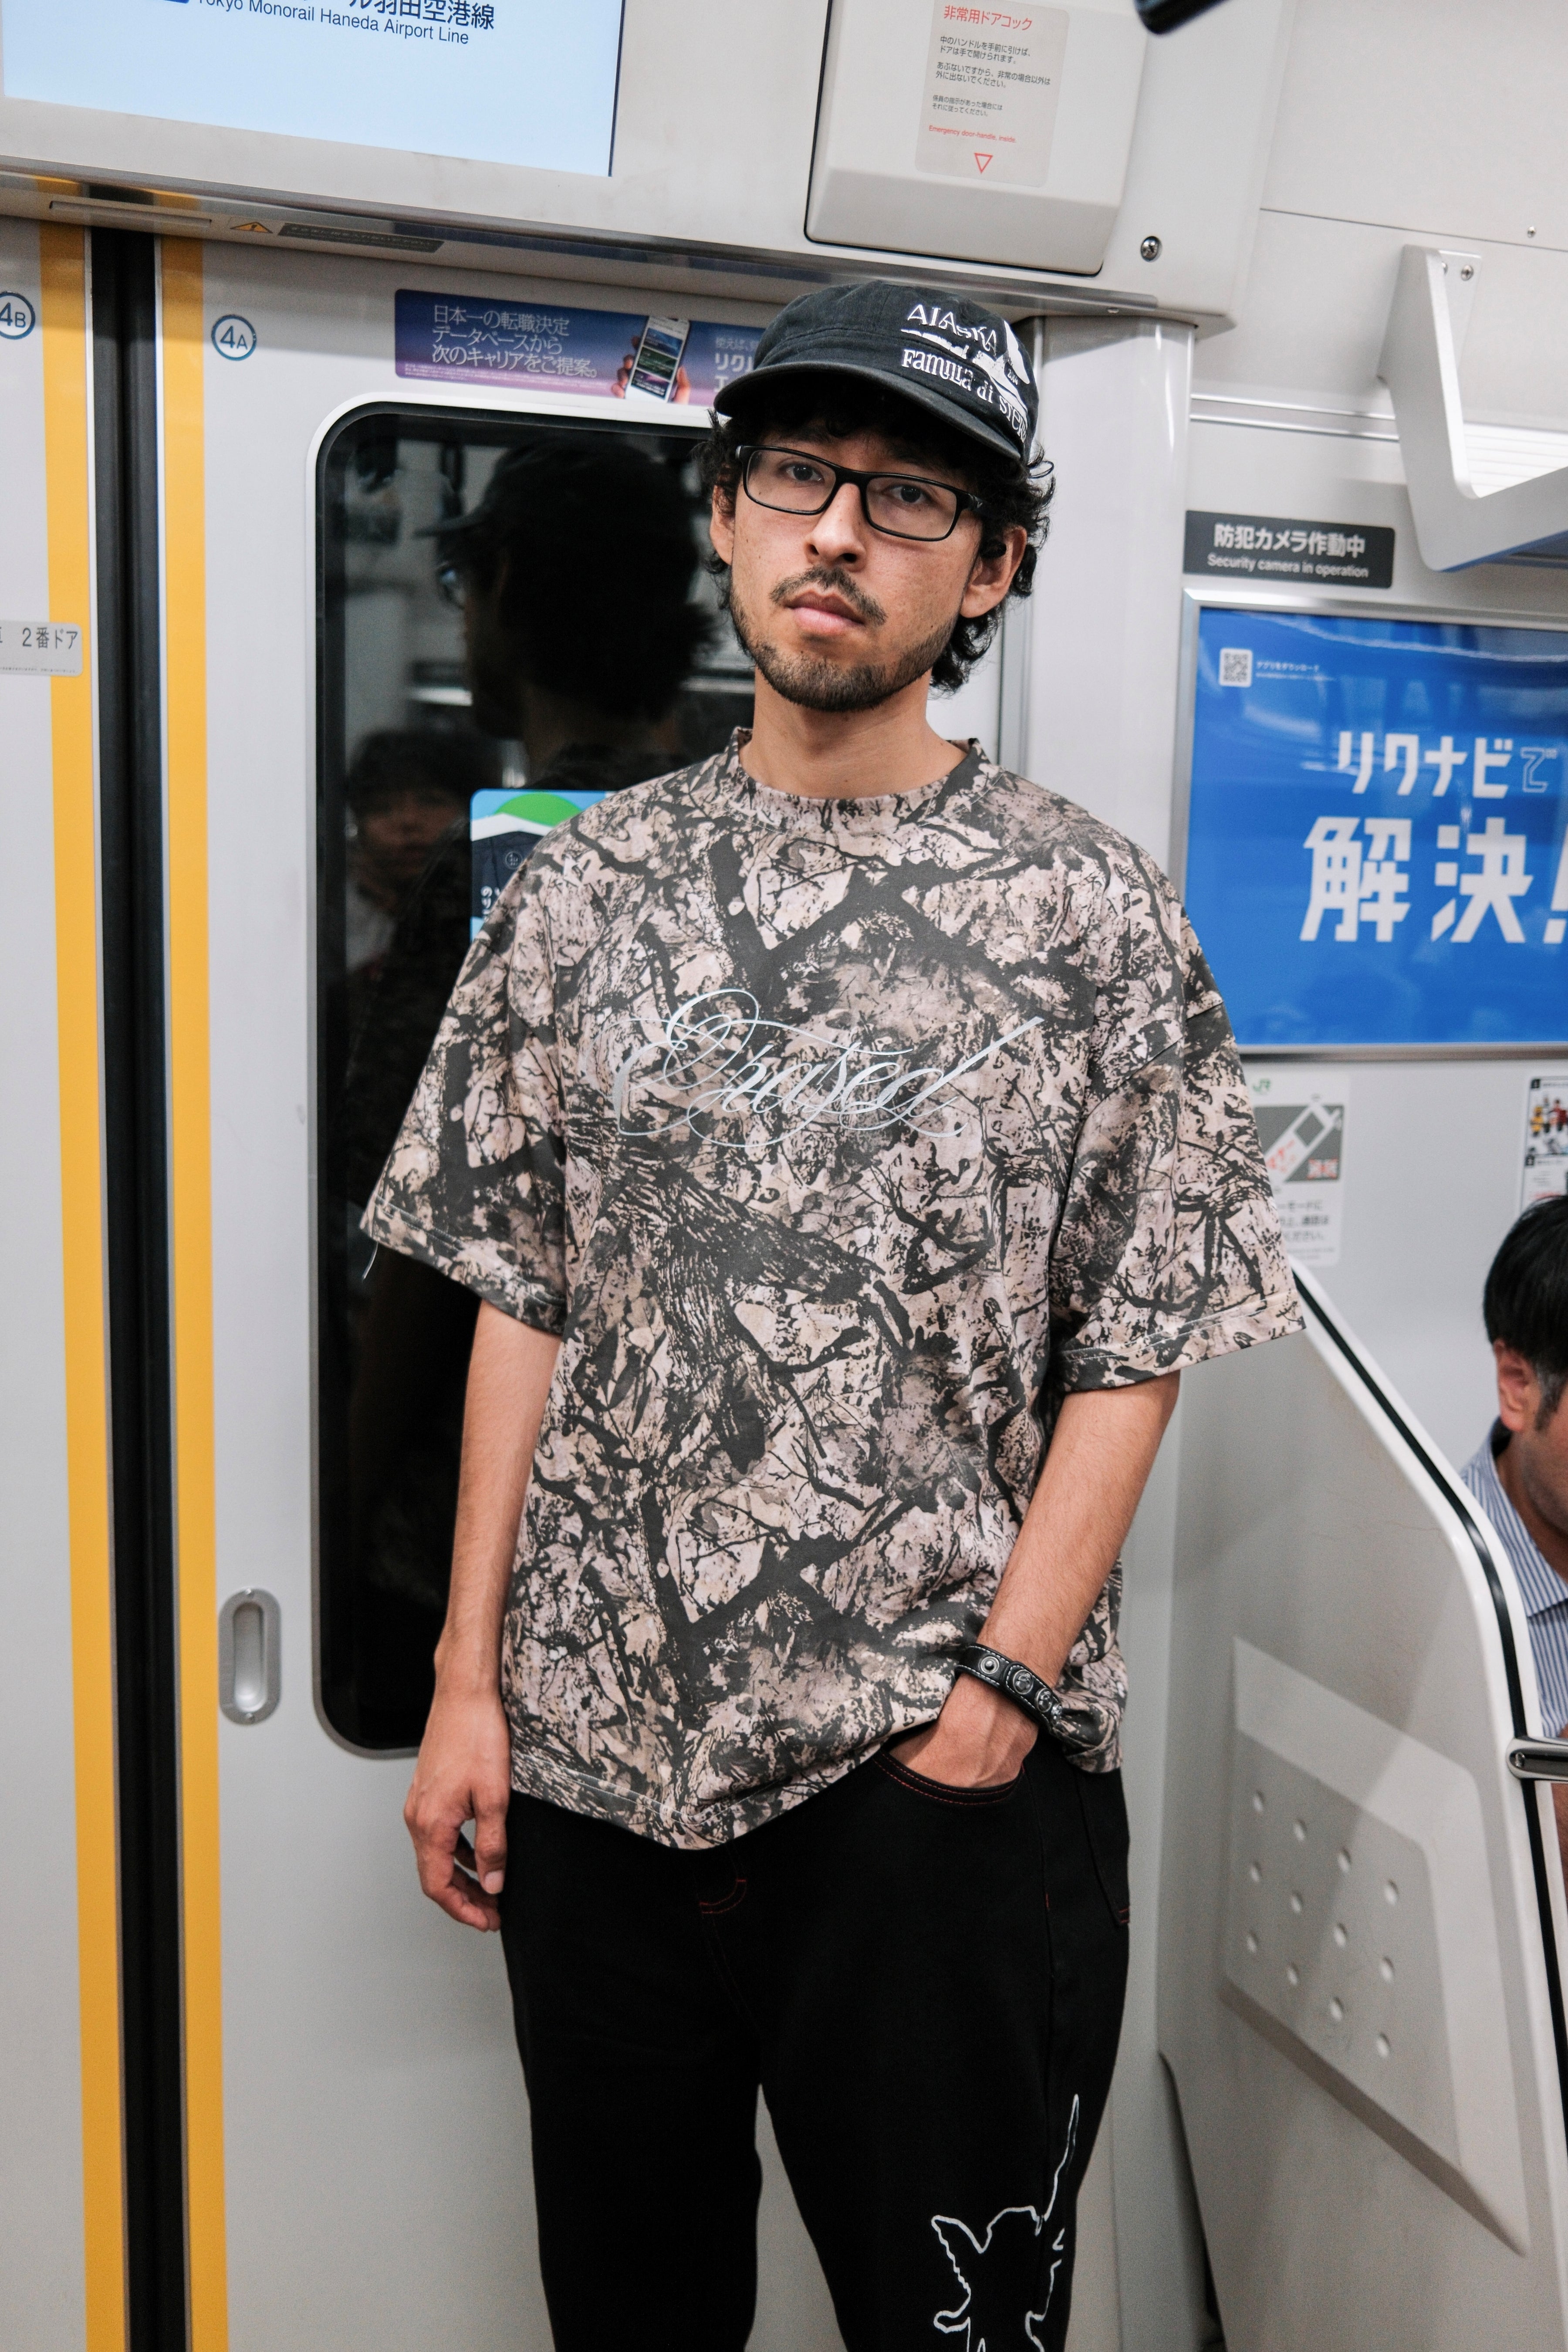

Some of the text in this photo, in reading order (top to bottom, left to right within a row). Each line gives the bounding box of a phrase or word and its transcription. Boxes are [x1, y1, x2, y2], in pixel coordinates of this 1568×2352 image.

[200, 0, 469, 44] okyo Monorail Haneda Airport Line
[944, 5, 1032, 30] 非常用ドアコック
[940, 36, 1031, 57] 中のハンドルを手前に引けば、
[940, 45, 1017, 64] ドアは手で開けられます。
[936, 71, 1007, 88] 外に出ないでください。
[937, 61, 1051, 85] あぶないですから、非常の場合以外は
[929, 125, 960, 136] Emergency
[0, 302, 26, 328] 4B
[434, 304, 570, 336] 日本一の転職決定
[220, 325, 248, 350] 4A
[432, 325, 563, 355] データベースから
[432, 344, 597, 378] 次のキャリアをご提案。
[977, 380, 994, 404] di
[1213, 524, 1366, 558] 防犯カメラ作動中
[1207, 553, 1369, 578] Security camera in operation
[22, 627, 78, 649] 2番ドア
[1338, 731, 1557, 798] リクナビで
